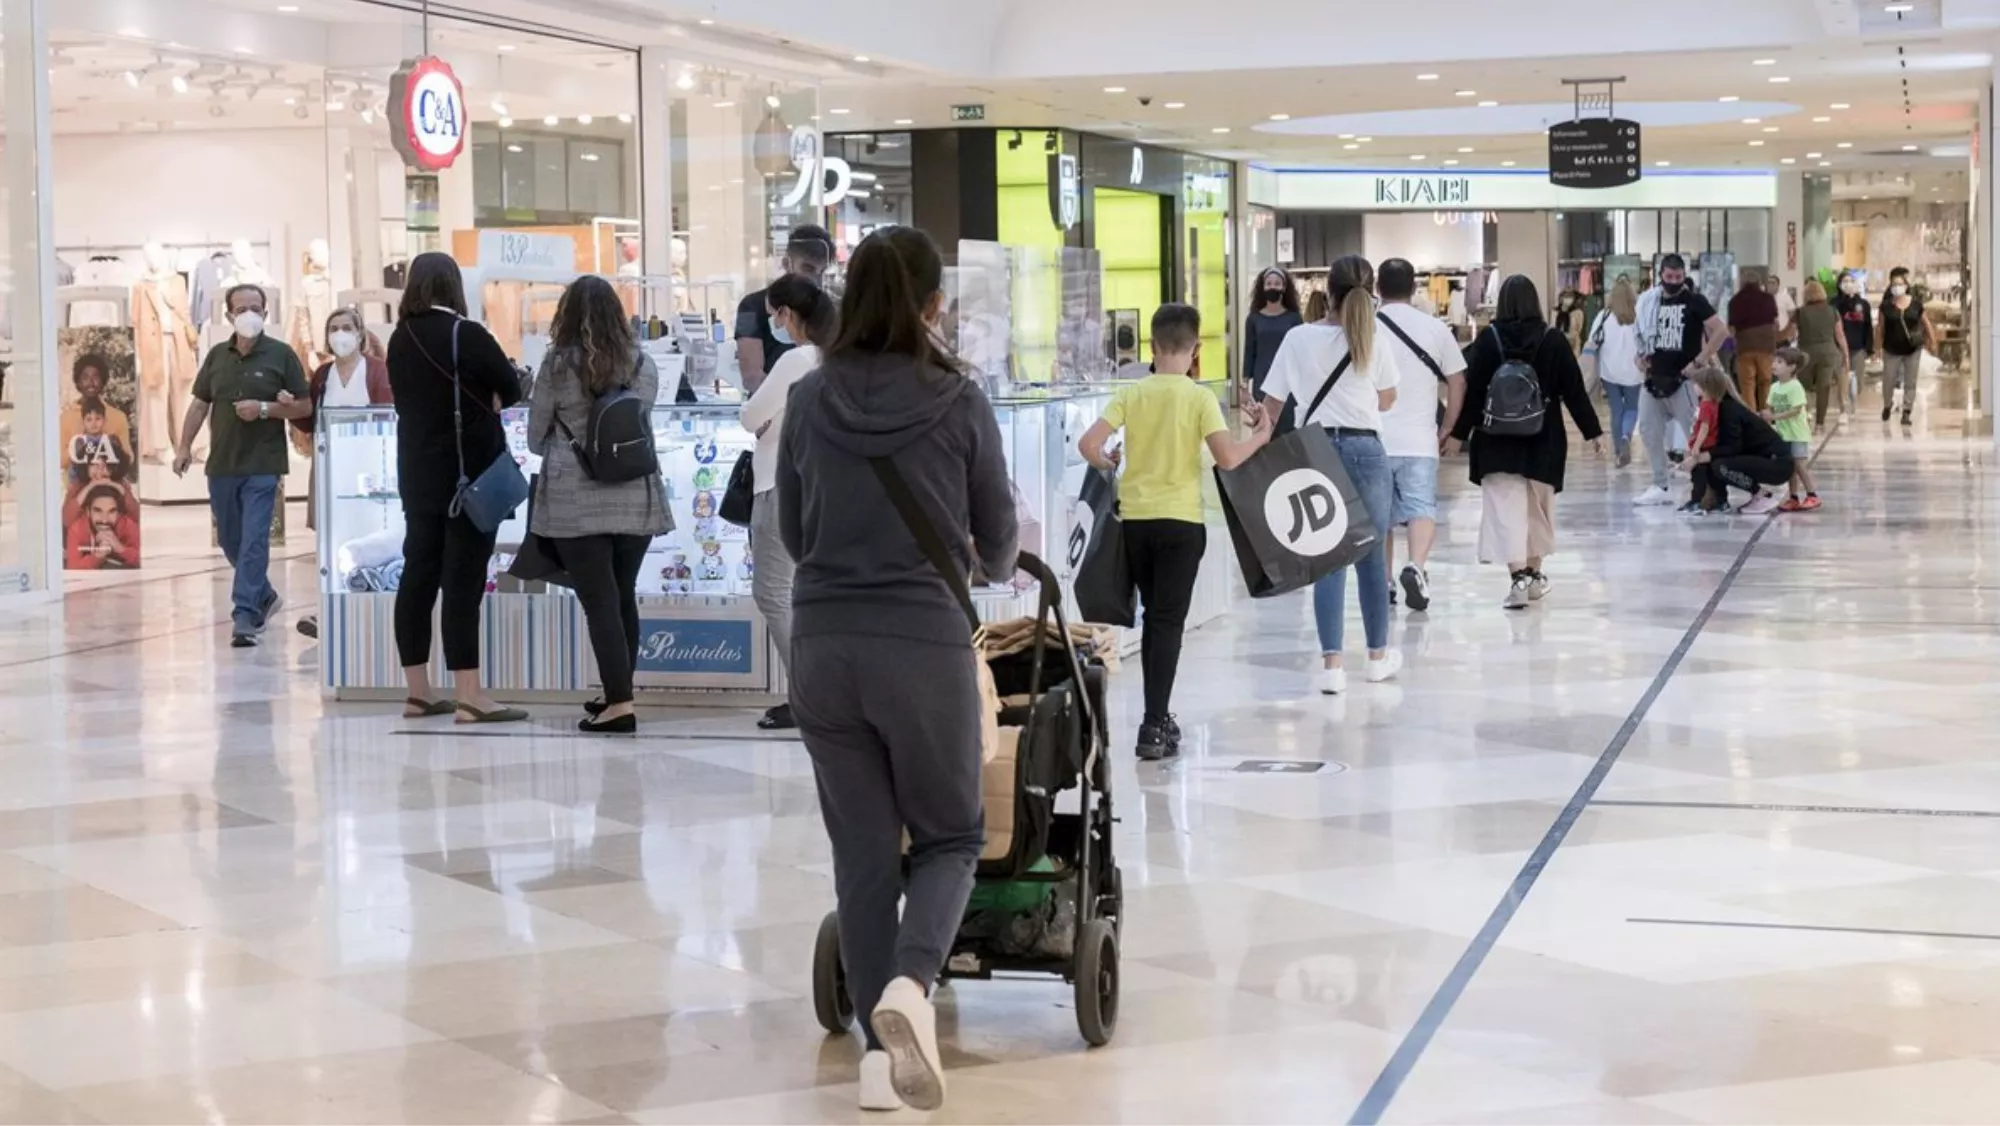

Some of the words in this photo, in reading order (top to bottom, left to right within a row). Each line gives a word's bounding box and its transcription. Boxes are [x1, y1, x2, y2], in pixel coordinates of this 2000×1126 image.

[419, 88, 460, 137] C&A
[781, 156, 850, 208] JD
[1375, 176, 1470, 204] KIABI
[67, 433, 120, 464] C&A
[1286, 483, 1337, 544] JD
[643, 630, 743, 662] Puntadas
